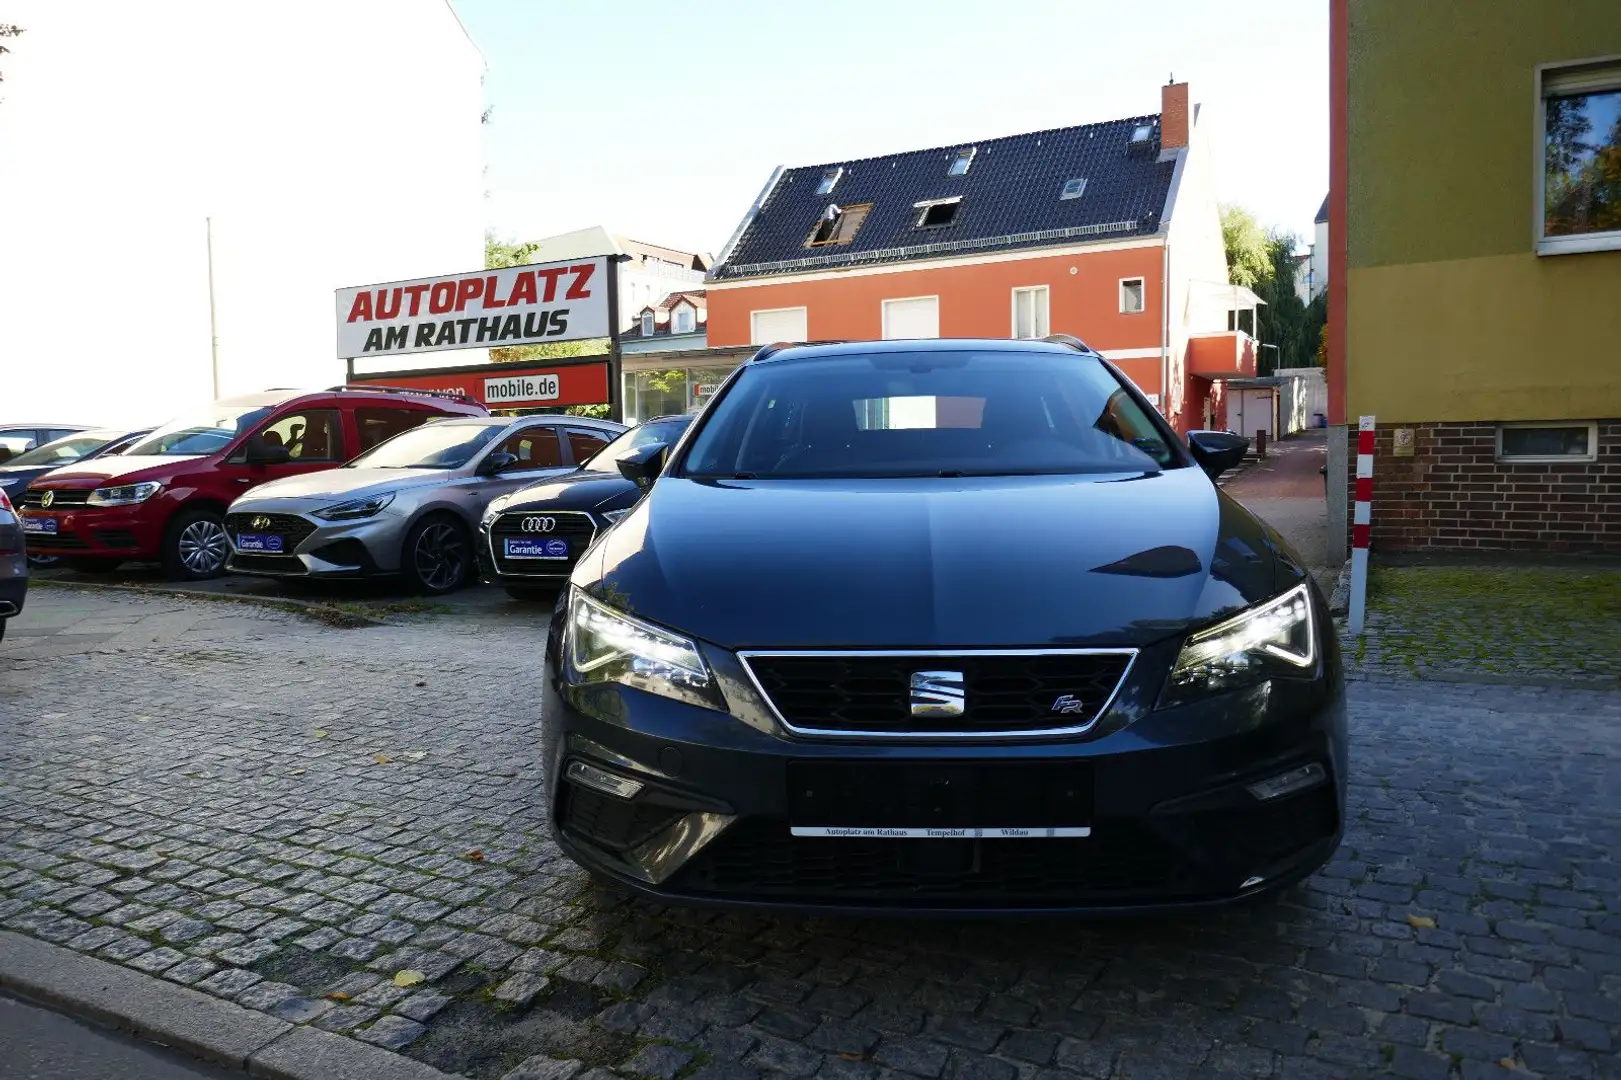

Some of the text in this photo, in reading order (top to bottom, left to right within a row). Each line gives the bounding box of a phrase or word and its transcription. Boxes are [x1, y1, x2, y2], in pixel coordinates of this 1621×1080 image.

[347, 263, 596, 323] AUTOPLATZ
[362, 309, 570, 352] AM RATHAUS
[487, 379, 557, 399] mobile.de
[241, 540, 263, 548] Garantie
[510, 544, 542, 554] Garantie
[825, 828, 861, 836] Autoplatz
[877, 828, 907, 836] Rathaus
[927, 829, 965, 838] Tempelhof
[1001, 828, 1029, 836] Wildau
